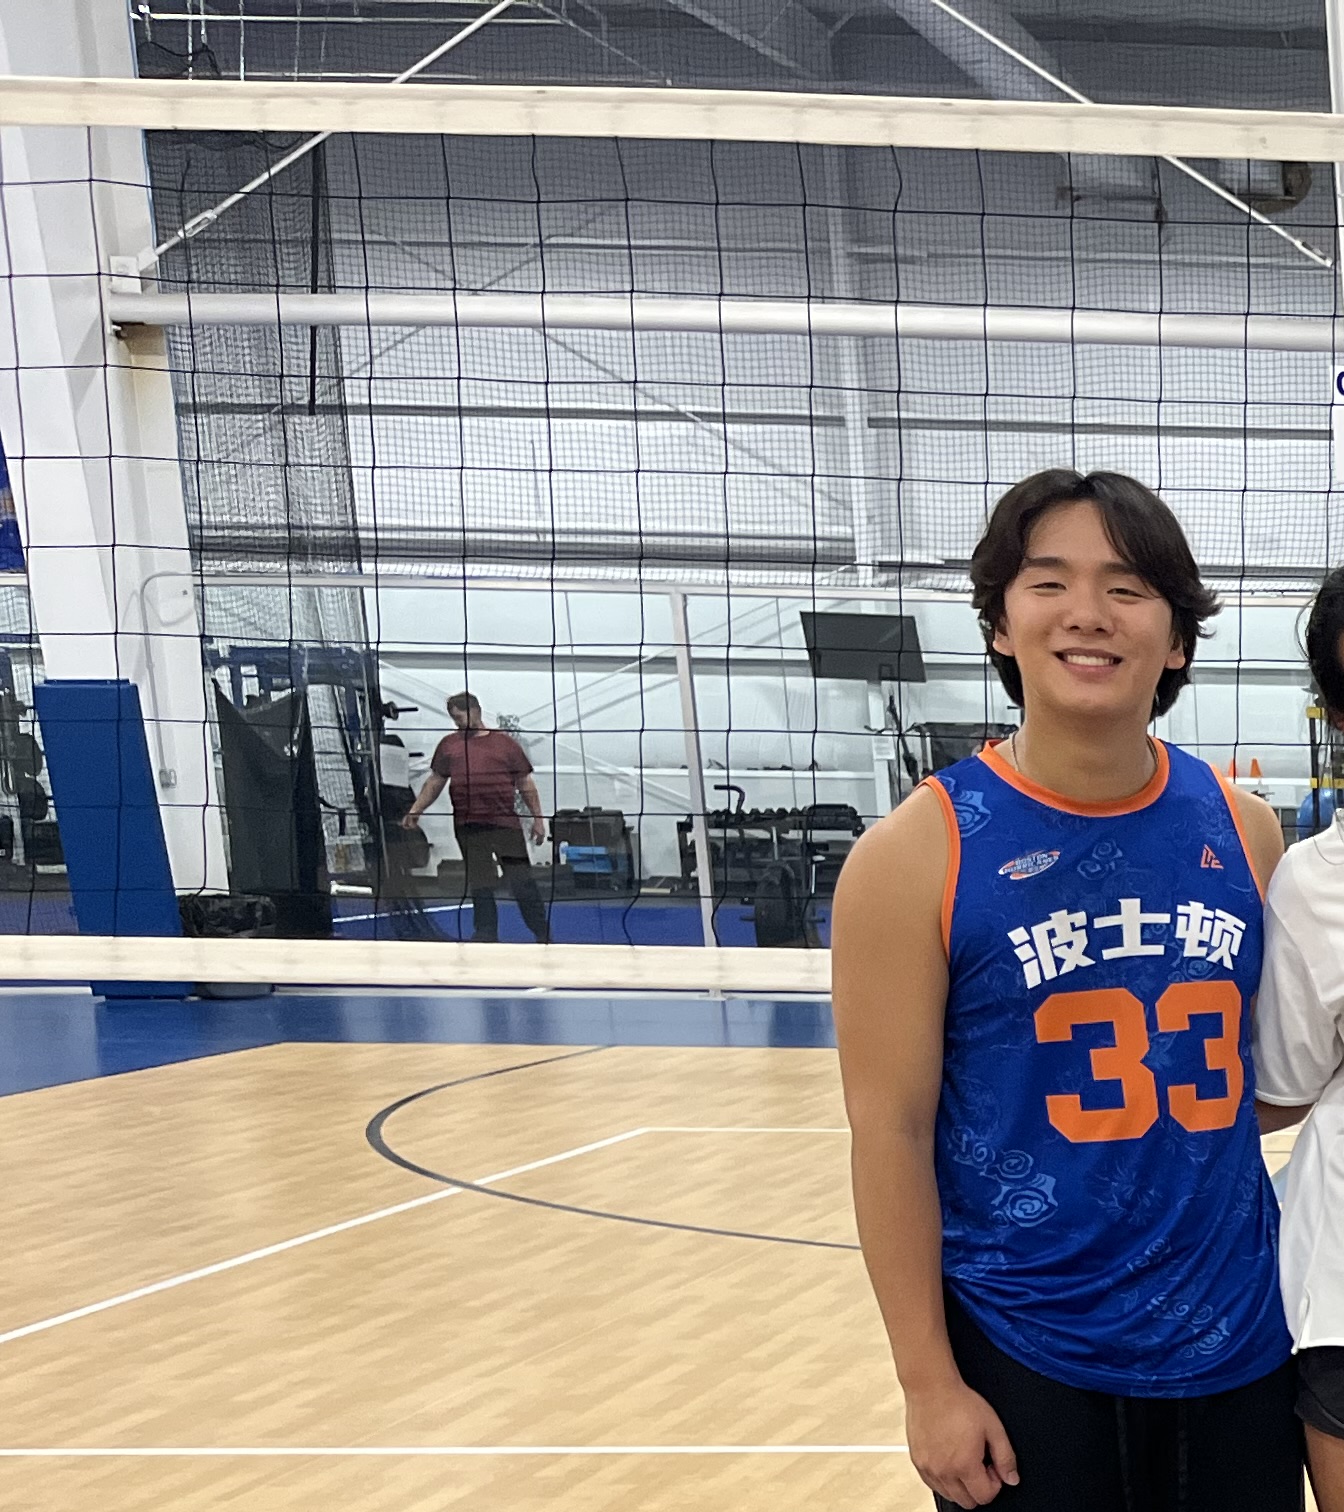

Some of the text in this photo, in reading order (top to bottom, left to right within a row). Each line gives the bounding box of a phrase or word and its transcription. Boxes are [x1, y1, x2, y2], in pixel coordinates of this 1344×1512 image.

[1007, 898, 1246, 989] 波士顿
[1034, 980, 1244, 1143] 33
